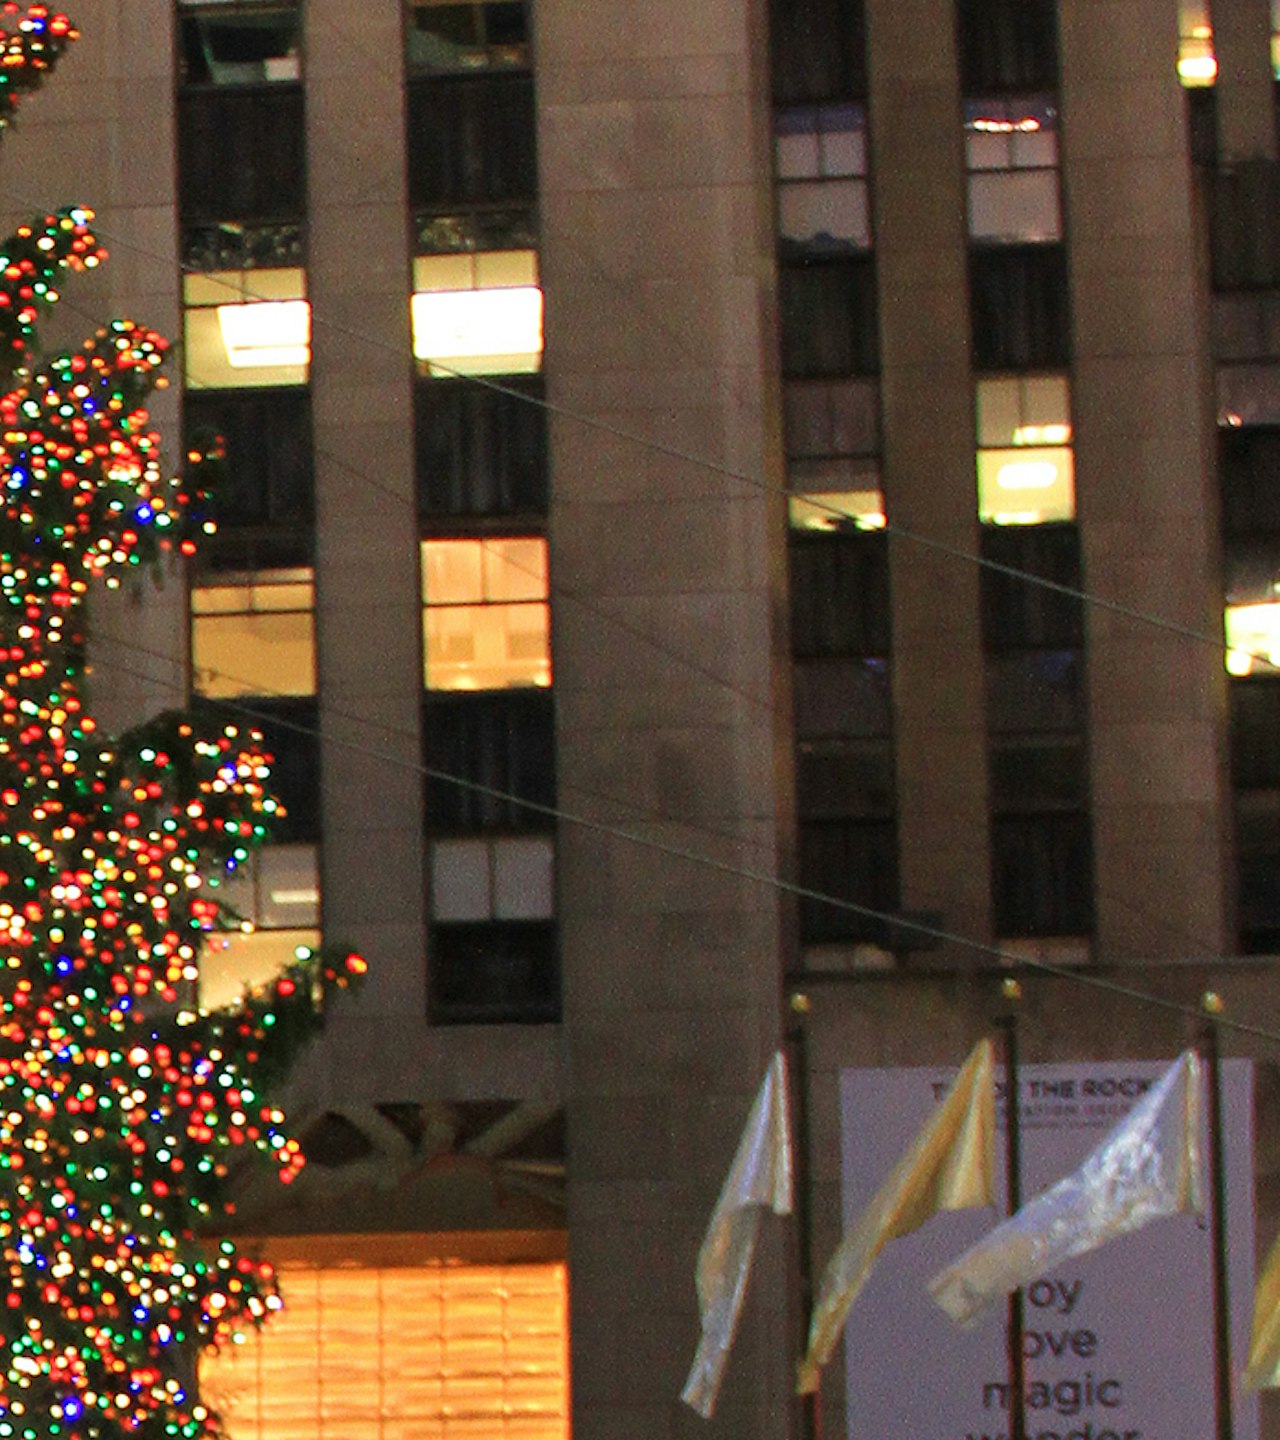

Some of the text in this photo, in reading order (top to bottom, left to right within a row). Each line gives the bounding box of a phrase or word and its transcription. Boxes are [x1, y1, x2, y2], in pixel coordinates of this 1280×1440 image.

[1028, 1078, 1076, 1099] THE
[1027, 1278, 1084, 1315] oy
[1021, 1328, 1097, 1359] ove
[982, 1371, 1123, 1416] magic
